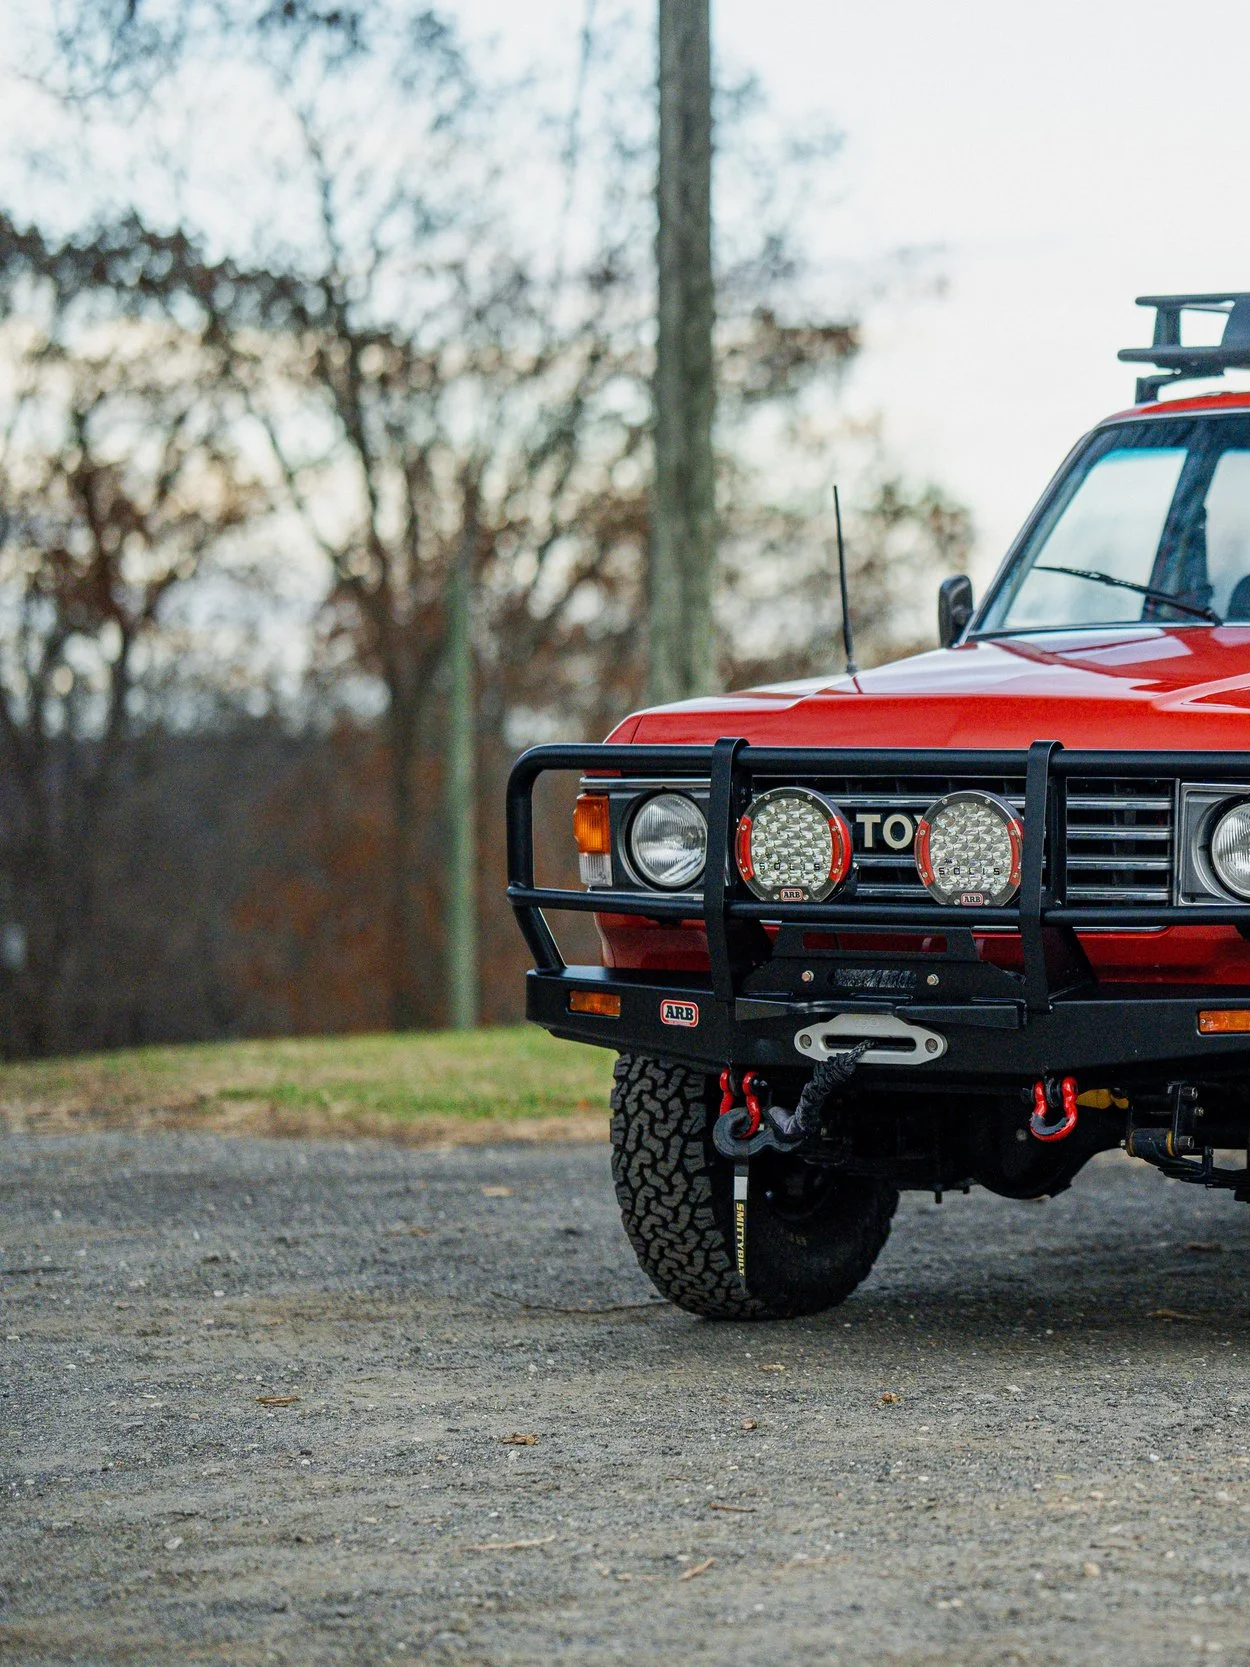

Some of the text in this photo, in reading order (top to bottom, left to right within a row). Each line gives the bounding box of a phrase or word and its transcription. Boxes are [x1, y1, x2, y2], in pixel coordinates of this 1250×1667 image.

[855, 813, 925, 850] TO
[938, 867, 1001, 876] SOLIS
[783, 890, 801, 898] ARB
[665, 1004, 694, 1021] ARB
[736, 1202, 745, 1276] SMITTYBILT
